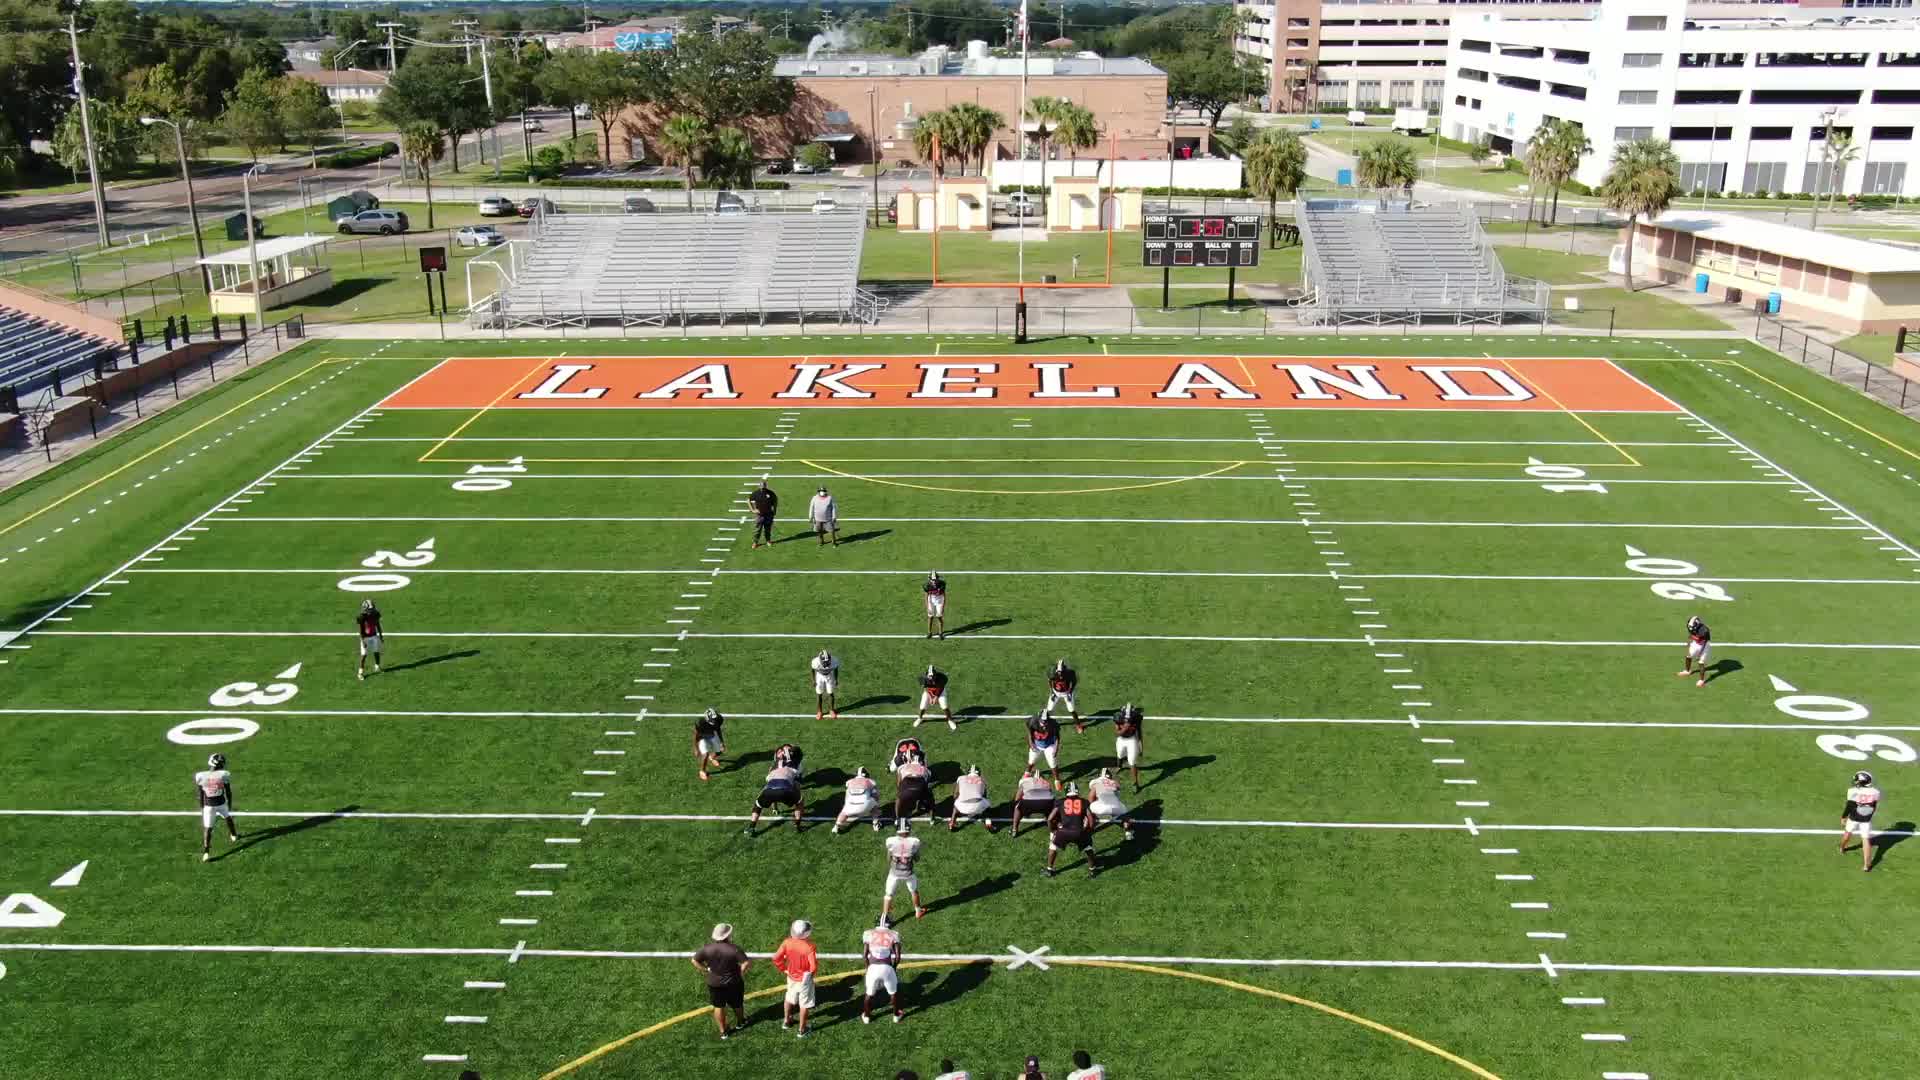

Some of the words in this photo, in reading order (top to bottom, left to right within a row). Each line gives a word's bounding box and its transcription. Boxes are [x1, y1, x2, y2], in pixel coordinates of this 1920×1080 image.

[1235, 215, 1258, 223] GUEST
[516, 362, 1536, 402] LAKELAND
[452, 463, 528, 492] 10
[1524, 465, 1609, 495] 10
[337, 550, 437, 592] 20
[1624, 557, 1735, 602] 20
[166, 681, 299, 745] 30
[1773, 694, 1919, 763] 30
[1064, 799, 1082, 815] 99
